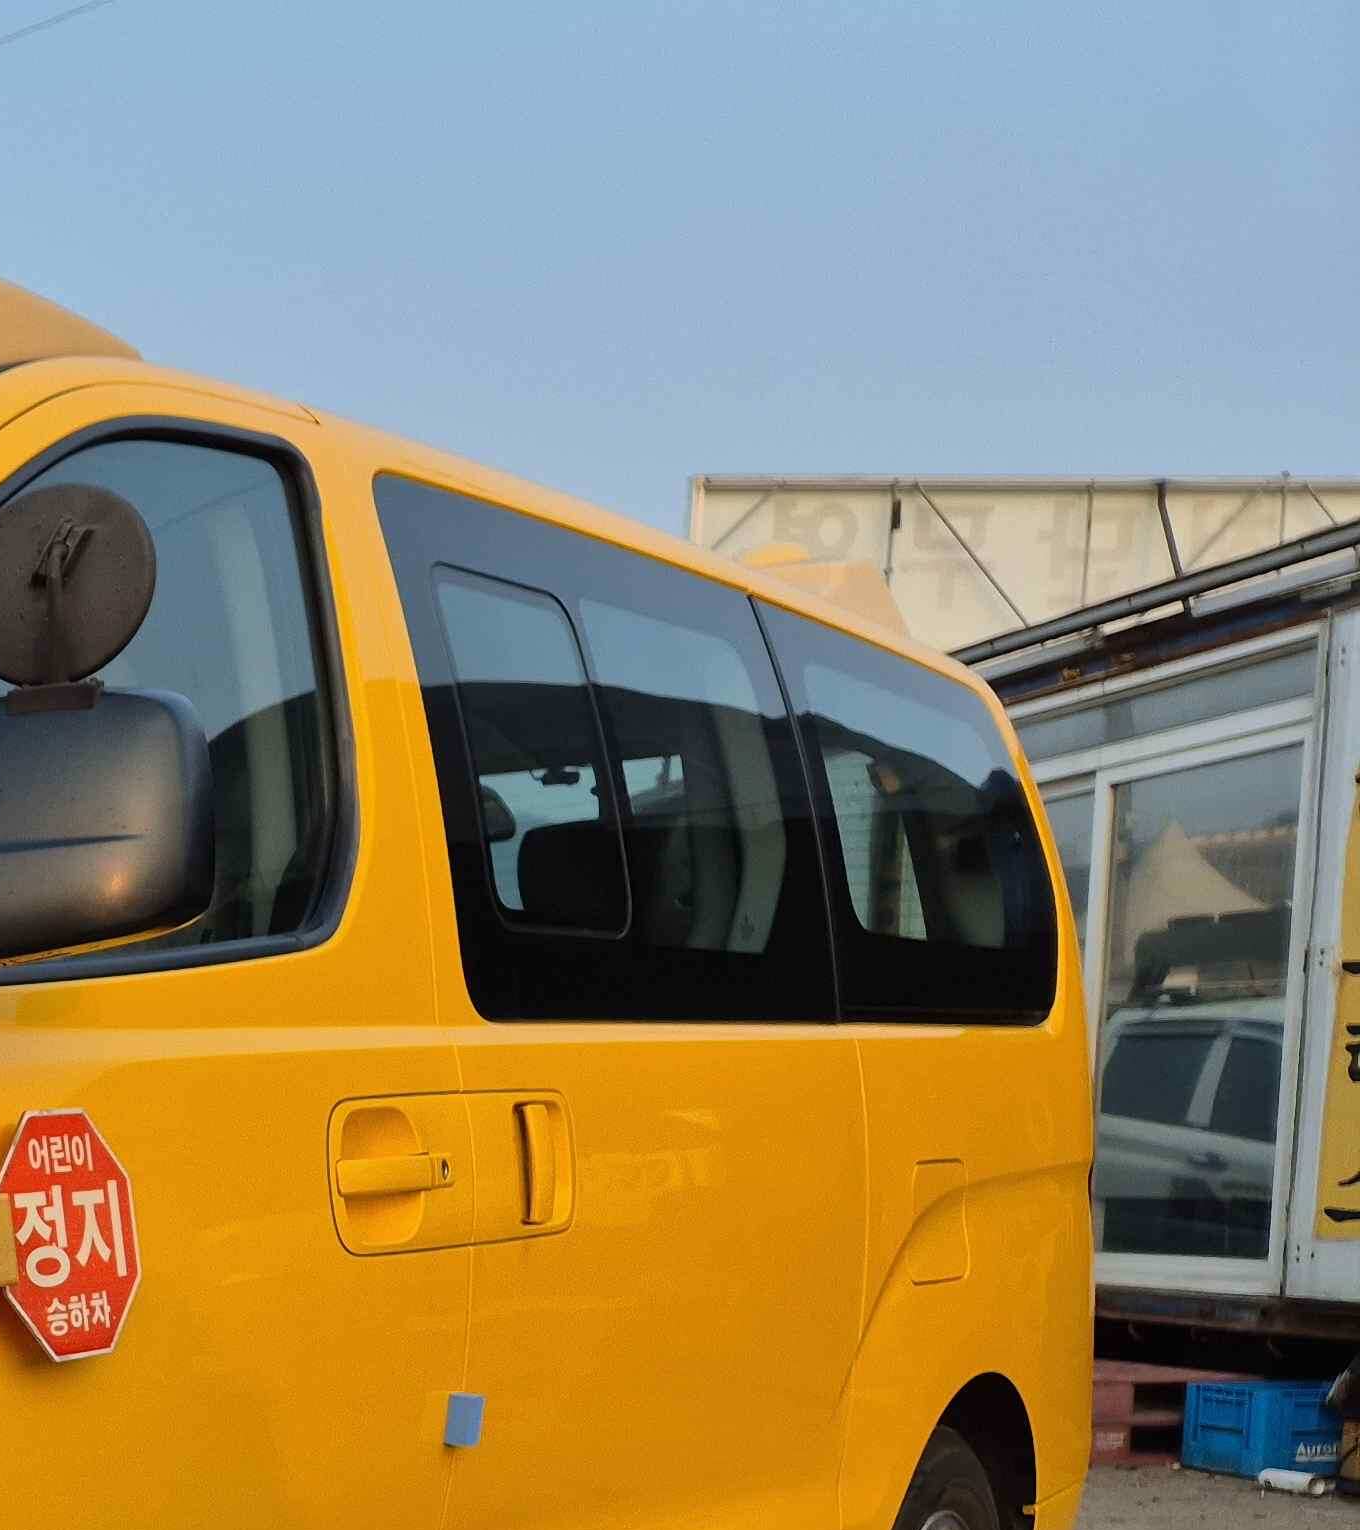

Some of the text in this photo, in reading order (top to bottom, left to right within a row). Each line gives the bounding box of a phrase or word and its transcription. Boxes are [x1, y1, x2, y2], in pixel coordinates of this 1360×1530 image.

[27, 1132, 94, 1175] 어린이
[15, 1179, 128, 1288] 정지
[46, 1290, 112, 1337] 승하차
